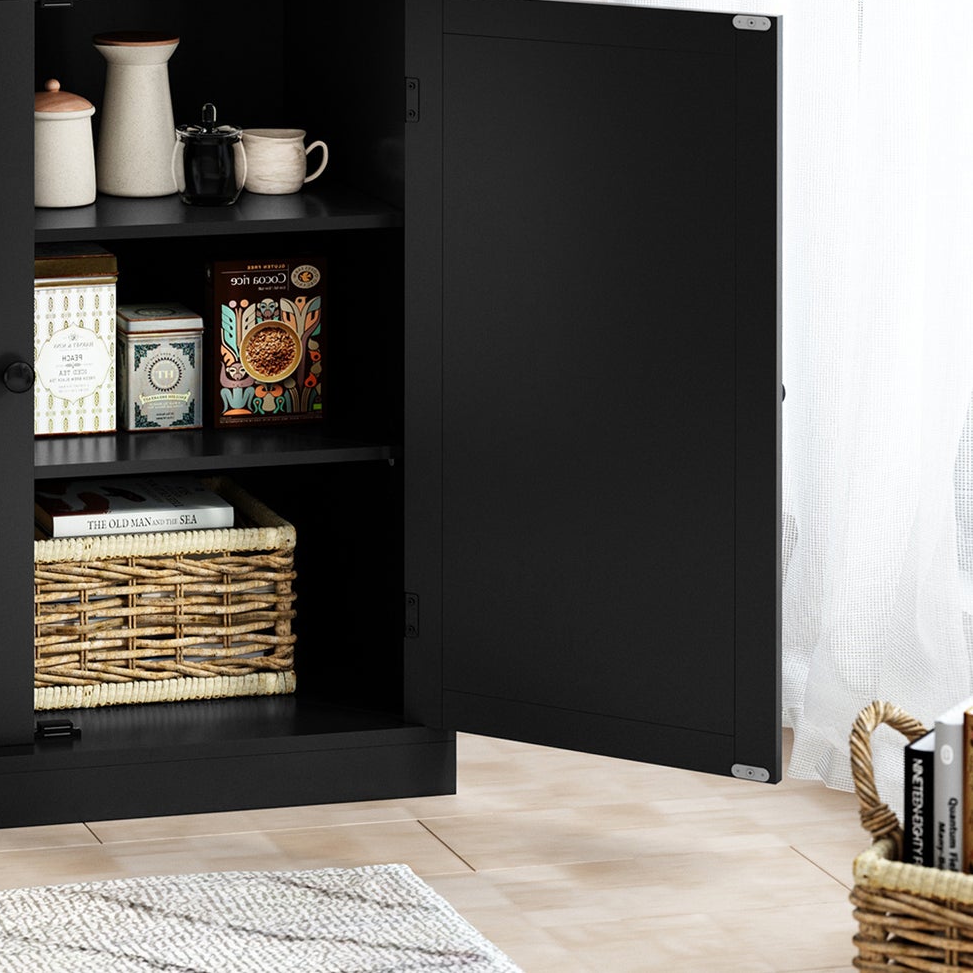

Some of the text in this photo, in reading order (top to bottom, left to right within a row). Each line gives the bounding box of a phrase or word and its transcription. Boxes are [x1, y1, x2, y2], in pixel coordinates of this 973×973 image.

[86, 514, 198, 530] THE OLD MAN AND THE SEA
[948, 798, 958, 849] Quantum
